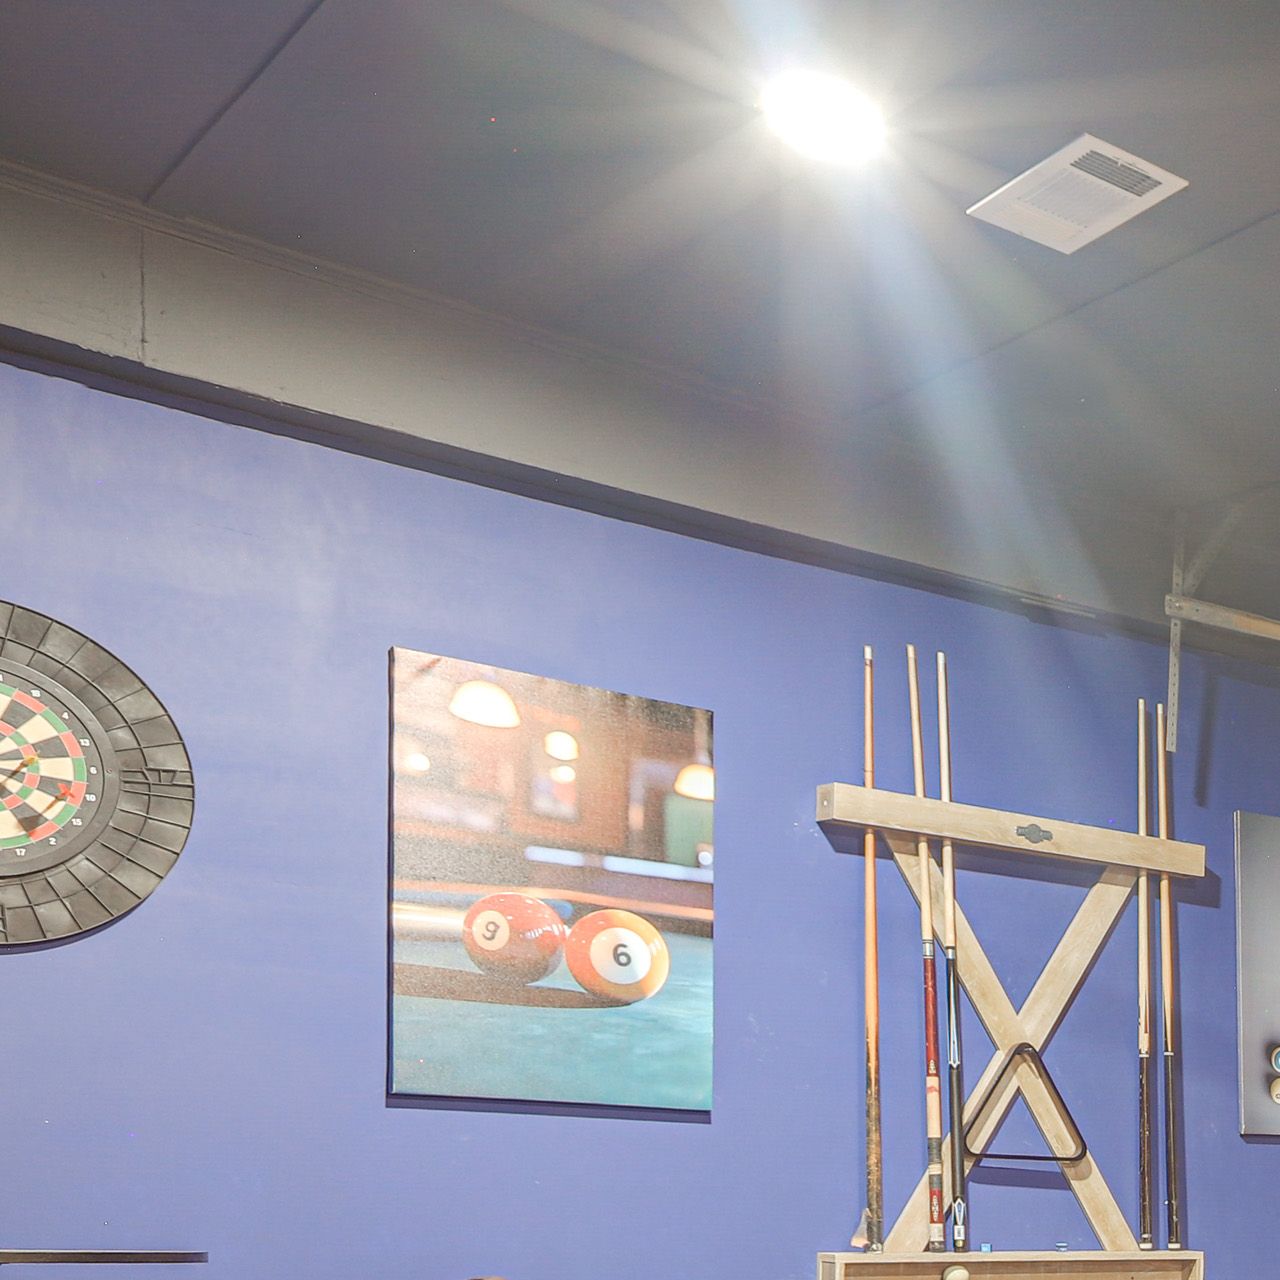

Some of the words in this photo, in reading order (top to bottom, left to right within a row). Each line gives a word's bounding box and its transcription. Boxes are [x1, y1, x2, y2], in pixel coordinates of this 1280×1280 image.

[62, 712, 69, 720] 4
[90, 766, 97, 774] 6
[85, 794, 96, 802] 10
[72, 818, 82, 826] 15
[49, 837, 57, 845] 2
[16, 848, 26, 856] 17
[482, 921, 500, 941] 9
[612, 943, 632, 967] 6
